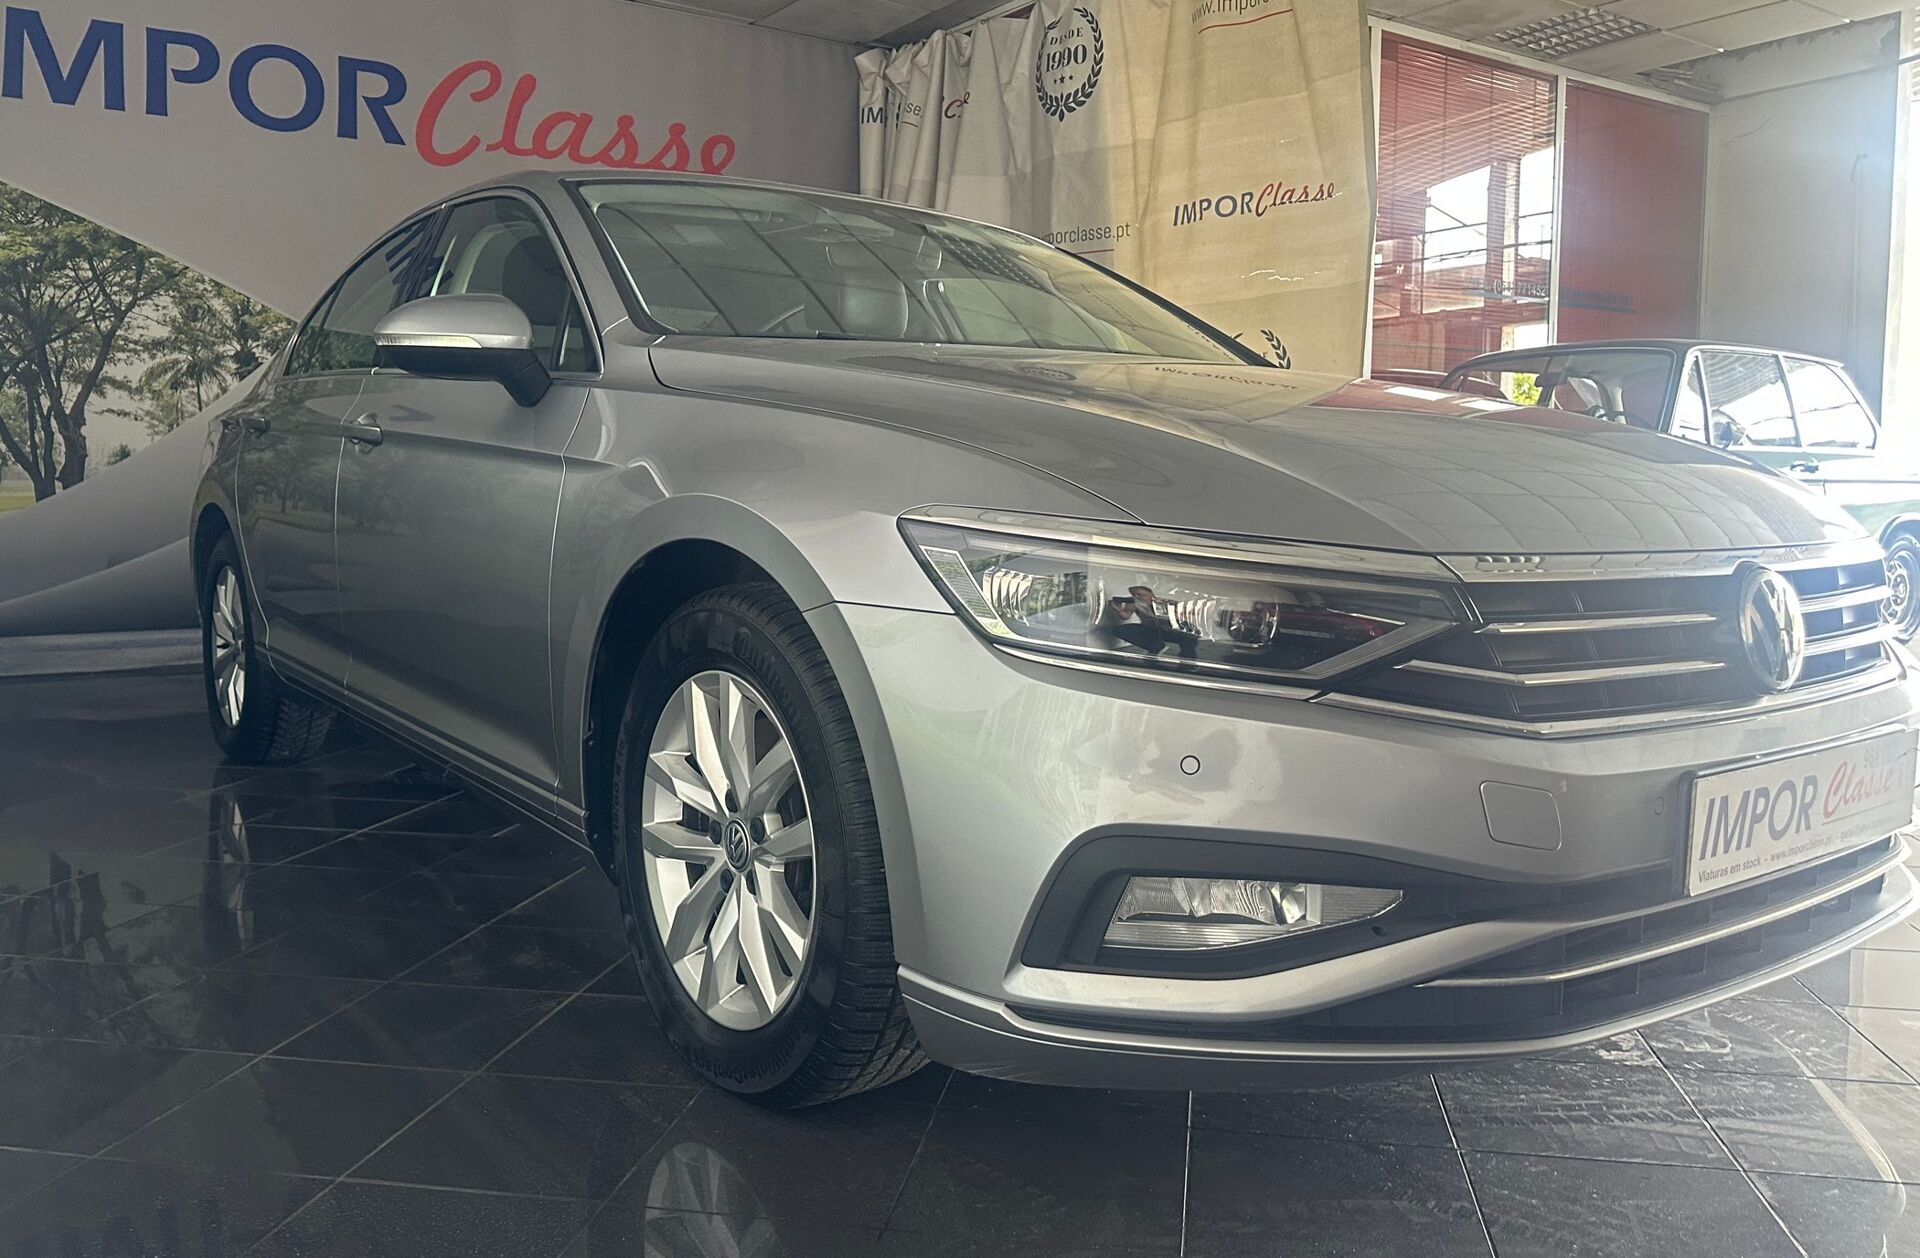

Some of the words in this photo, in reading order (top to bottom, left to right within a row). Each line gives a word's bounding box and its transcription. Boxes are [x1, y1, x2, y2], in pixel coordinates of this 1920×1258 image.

[1046, 44, 1088, 72] 1990
[1698, 866, 1729, 883] Viaturas
[1730, 863, 1741, 874] em
[1742, 856, 1761, 871] stock
